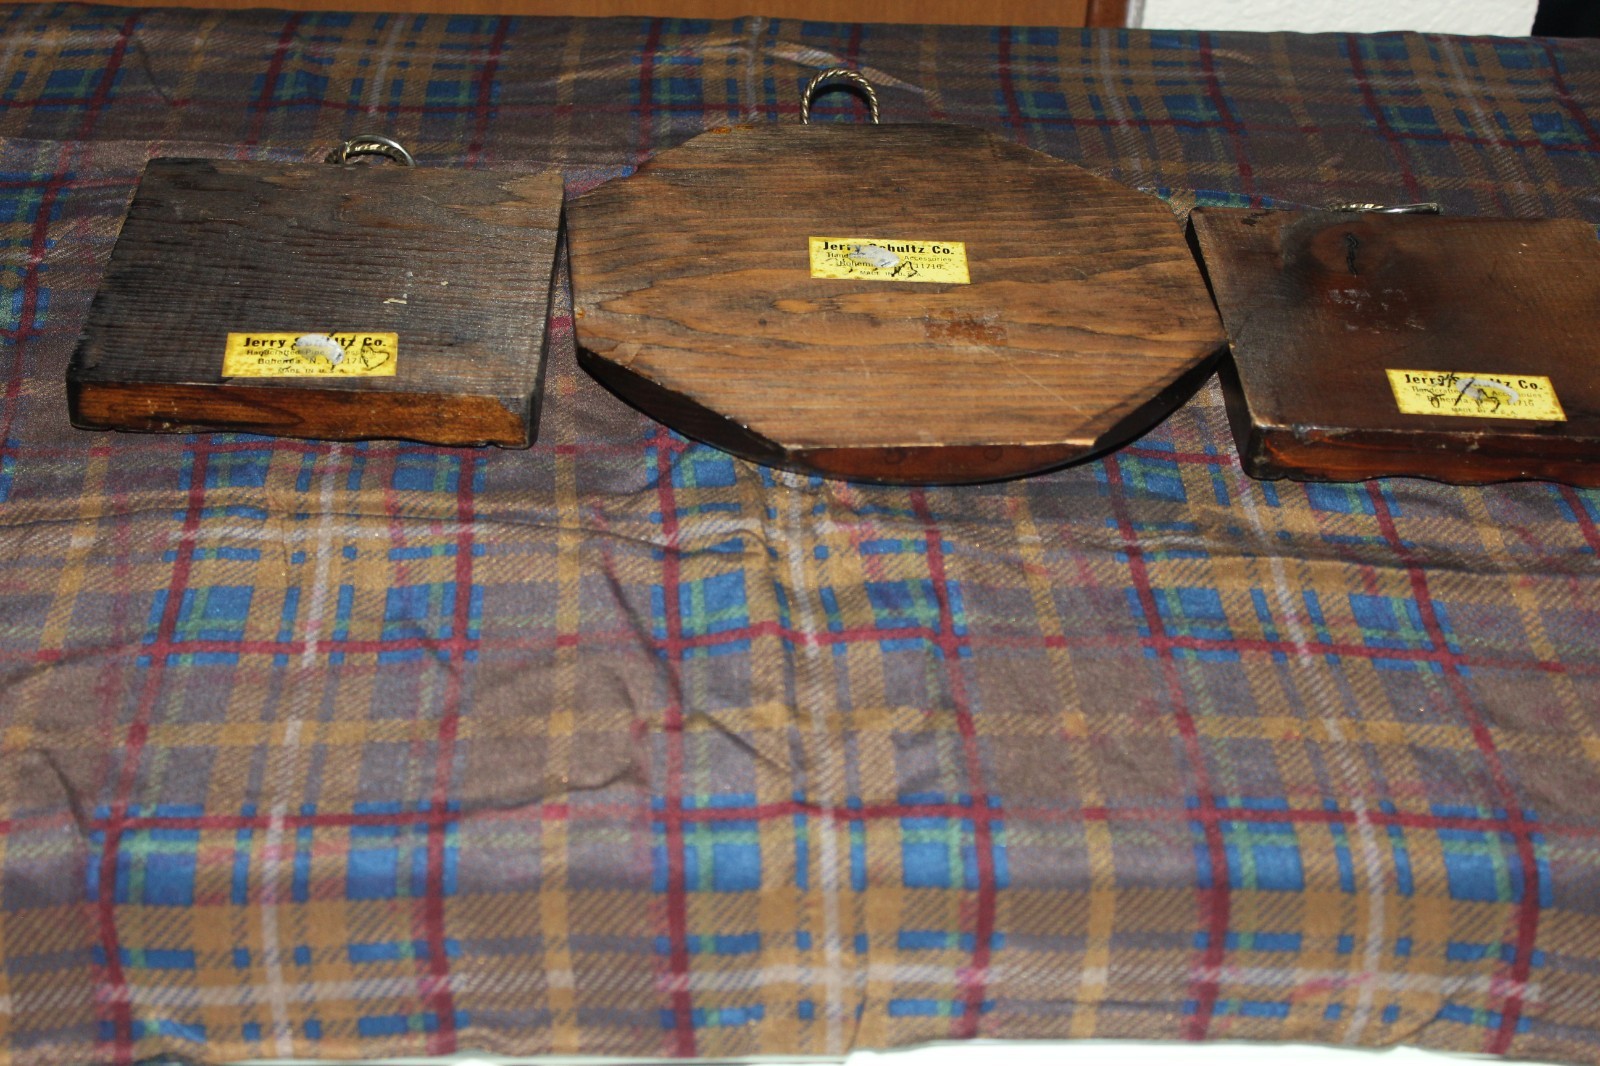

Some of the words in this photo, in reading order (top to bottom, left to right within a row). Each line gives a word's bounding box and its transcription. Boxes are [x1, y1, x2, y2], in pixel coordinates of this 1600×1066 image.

[823, 241, 860, 251] Jer
[868, 243, 925, 254] hultz
[931, 245, 955, 255] Co.
[243, 337, 286, 349] Jerry
[363, 336, 387, 347] Co.
[1518, 379, 1543, 390] Co.
